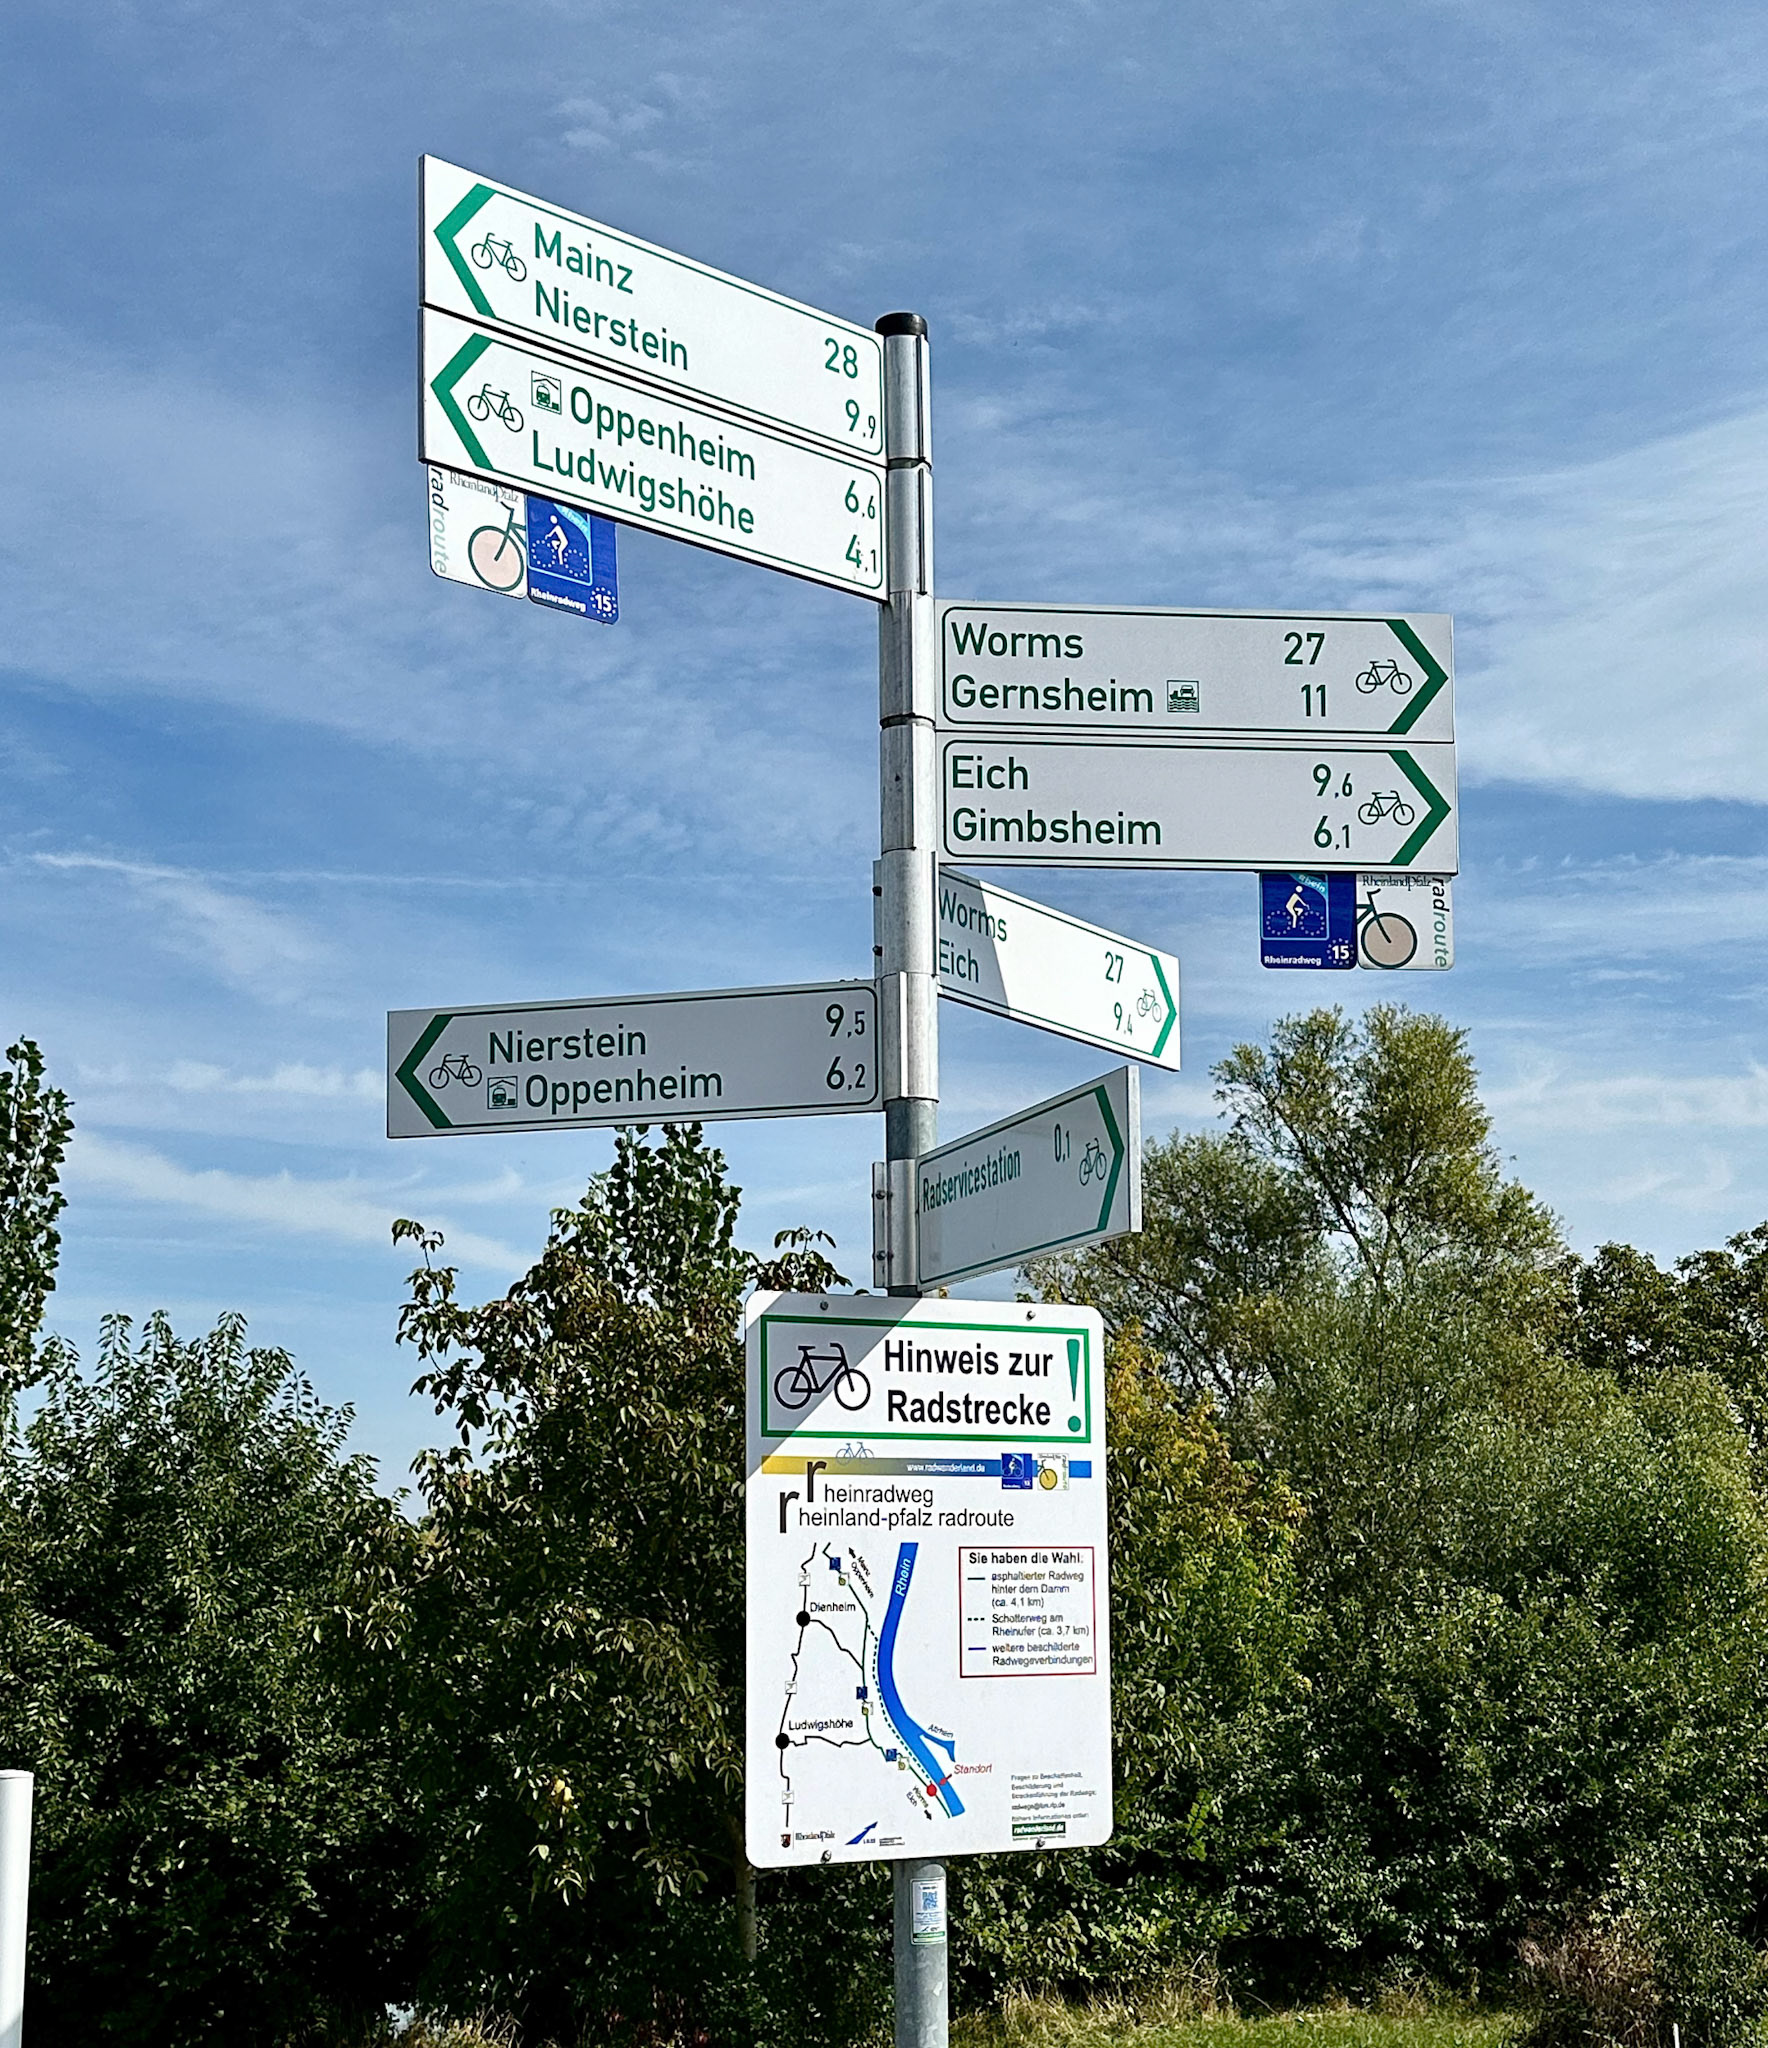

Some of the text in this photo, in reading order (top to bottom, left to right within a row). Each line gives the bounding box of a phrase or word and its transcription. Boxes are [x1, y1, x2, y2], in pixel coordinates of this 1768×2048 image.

[534, 222, 858, 379] Mainz 28
[535, 280, 876, 440] Nierstein 9,9
[570, 386, 875, 520] Oppenheim 6,6
[533, 430, 876, 574] Ludwigshöhe 4,1
[431, 468, 449, 574] radroute
[530, 587, 586, 613] Rheinradweg
[595, 594, 611, 612] 15
[951, 622, 1325, 665] Worms 27
[952, 675, 1327, 717] Gernsheim 11
[952, 756, 1352, 798] Eich 9,6
[953, 808, 1351, 849] Gimbsheim 6,1
[939, 889, 1123, 983] Worms 27
[1432, 877, 1450, 967] radroute
[939, 938, 979, 983] Eich
[1264, 956, 1322, 966] Rheinradweg
[1332, 945, 1350, 960] 15
[489, 1004, 866, 1065] Nierstein 9,5
[525, 1056, 866, 1115] Oppenheim 6,2
[922, 1123, 1070, 1213] Radservicestation 0,1
[885, 1340, 1054, 1377] Hinweis zur
[888, 1390, 1051, 1426] Radstrecke
[939, 1509, 1014, 1527] radroute
[969, 1552, 1084, 1564] Sie haben die Wahl:
[991, 1570, 1084, 1582] asphaltierter Radweg
[895, 1558, 911, 1597] Rhein
[992, 1584, 1070, 1594] hinter dem Damm
[810, 1602, 856, 1612] Dienheim
[991, 1597, 1044, 1609] (ca. 4,1 km)
[992, 1613, 1064, 1624] Schotterweg am
[992, 1625, 1090, 1637] Rheinufer (ca. 3,7 km)
[992, 1642, 1080, 1653] weitere beschilderte
[789, 1719, 853, 1731] Ludwigshöhe
[954, 1764, 992, 1775] Standort
